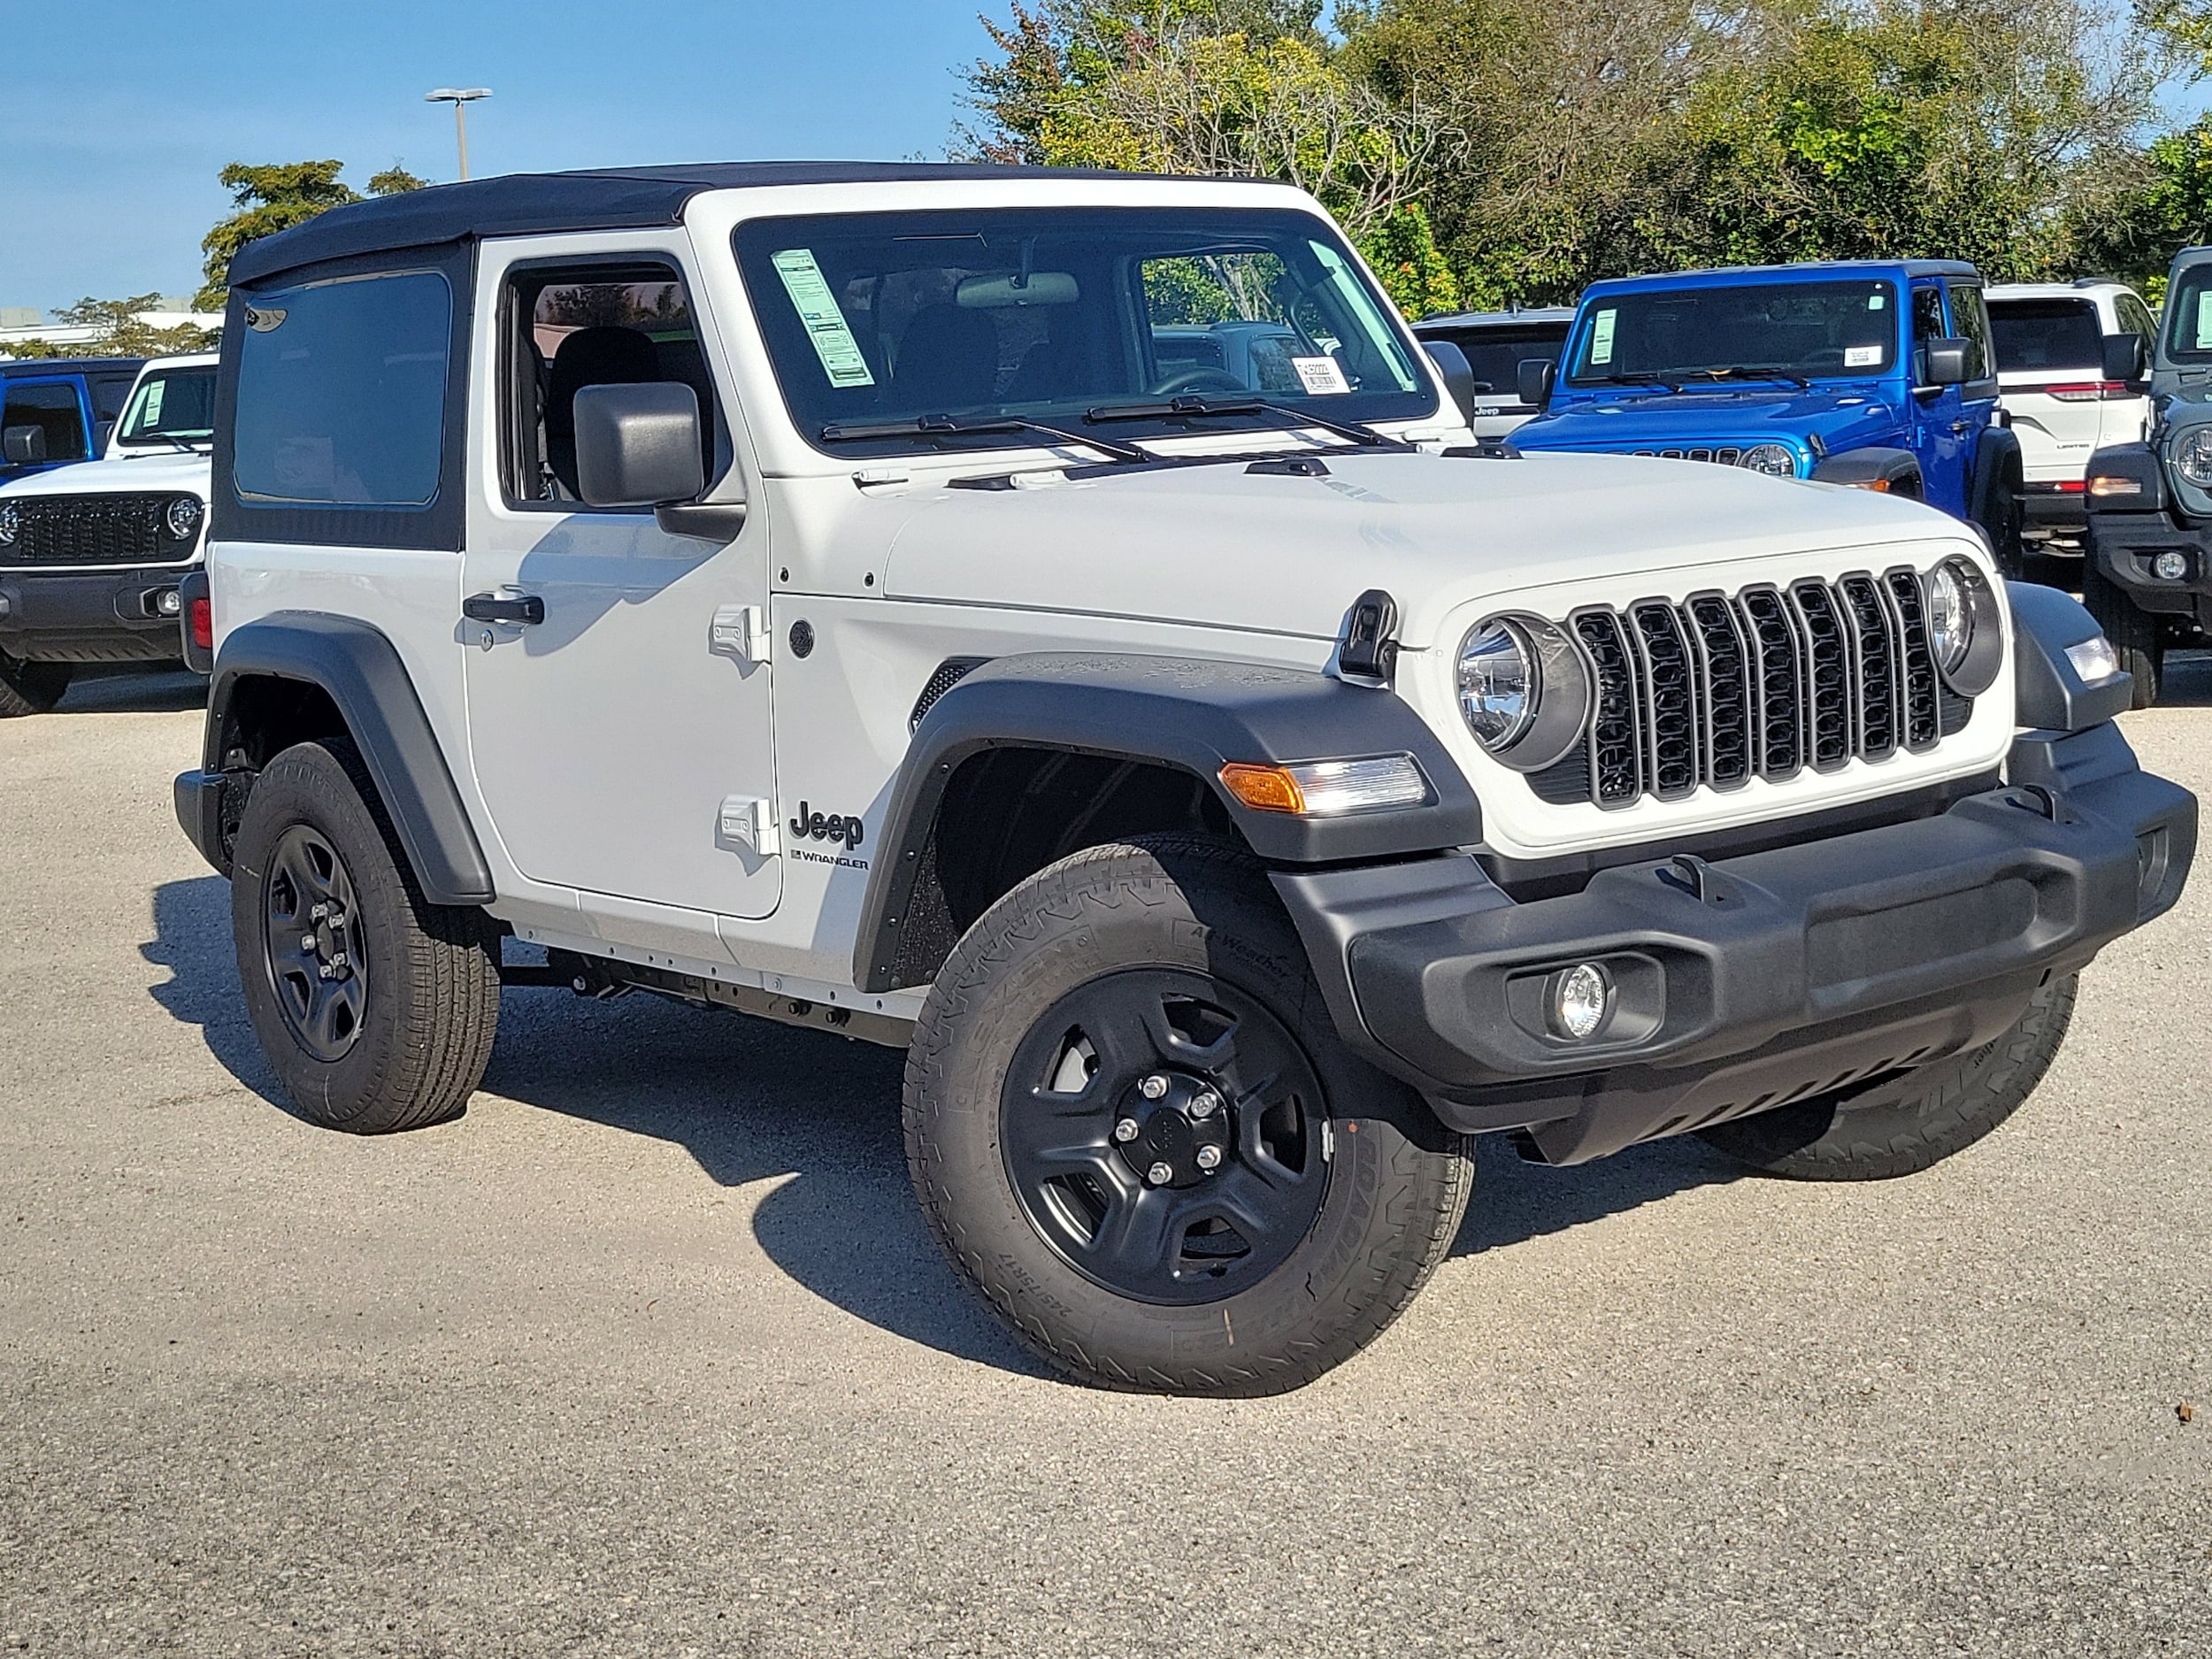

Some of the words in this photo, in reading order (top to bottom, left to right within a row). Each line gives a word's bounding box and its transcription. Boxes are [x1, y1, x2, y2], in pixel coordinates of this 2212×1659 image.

[1475, 407, 1499, 416] Jeep
[790, 801, 864, 851] Jeep
[802, 851, 869, 871] WRANGLER
